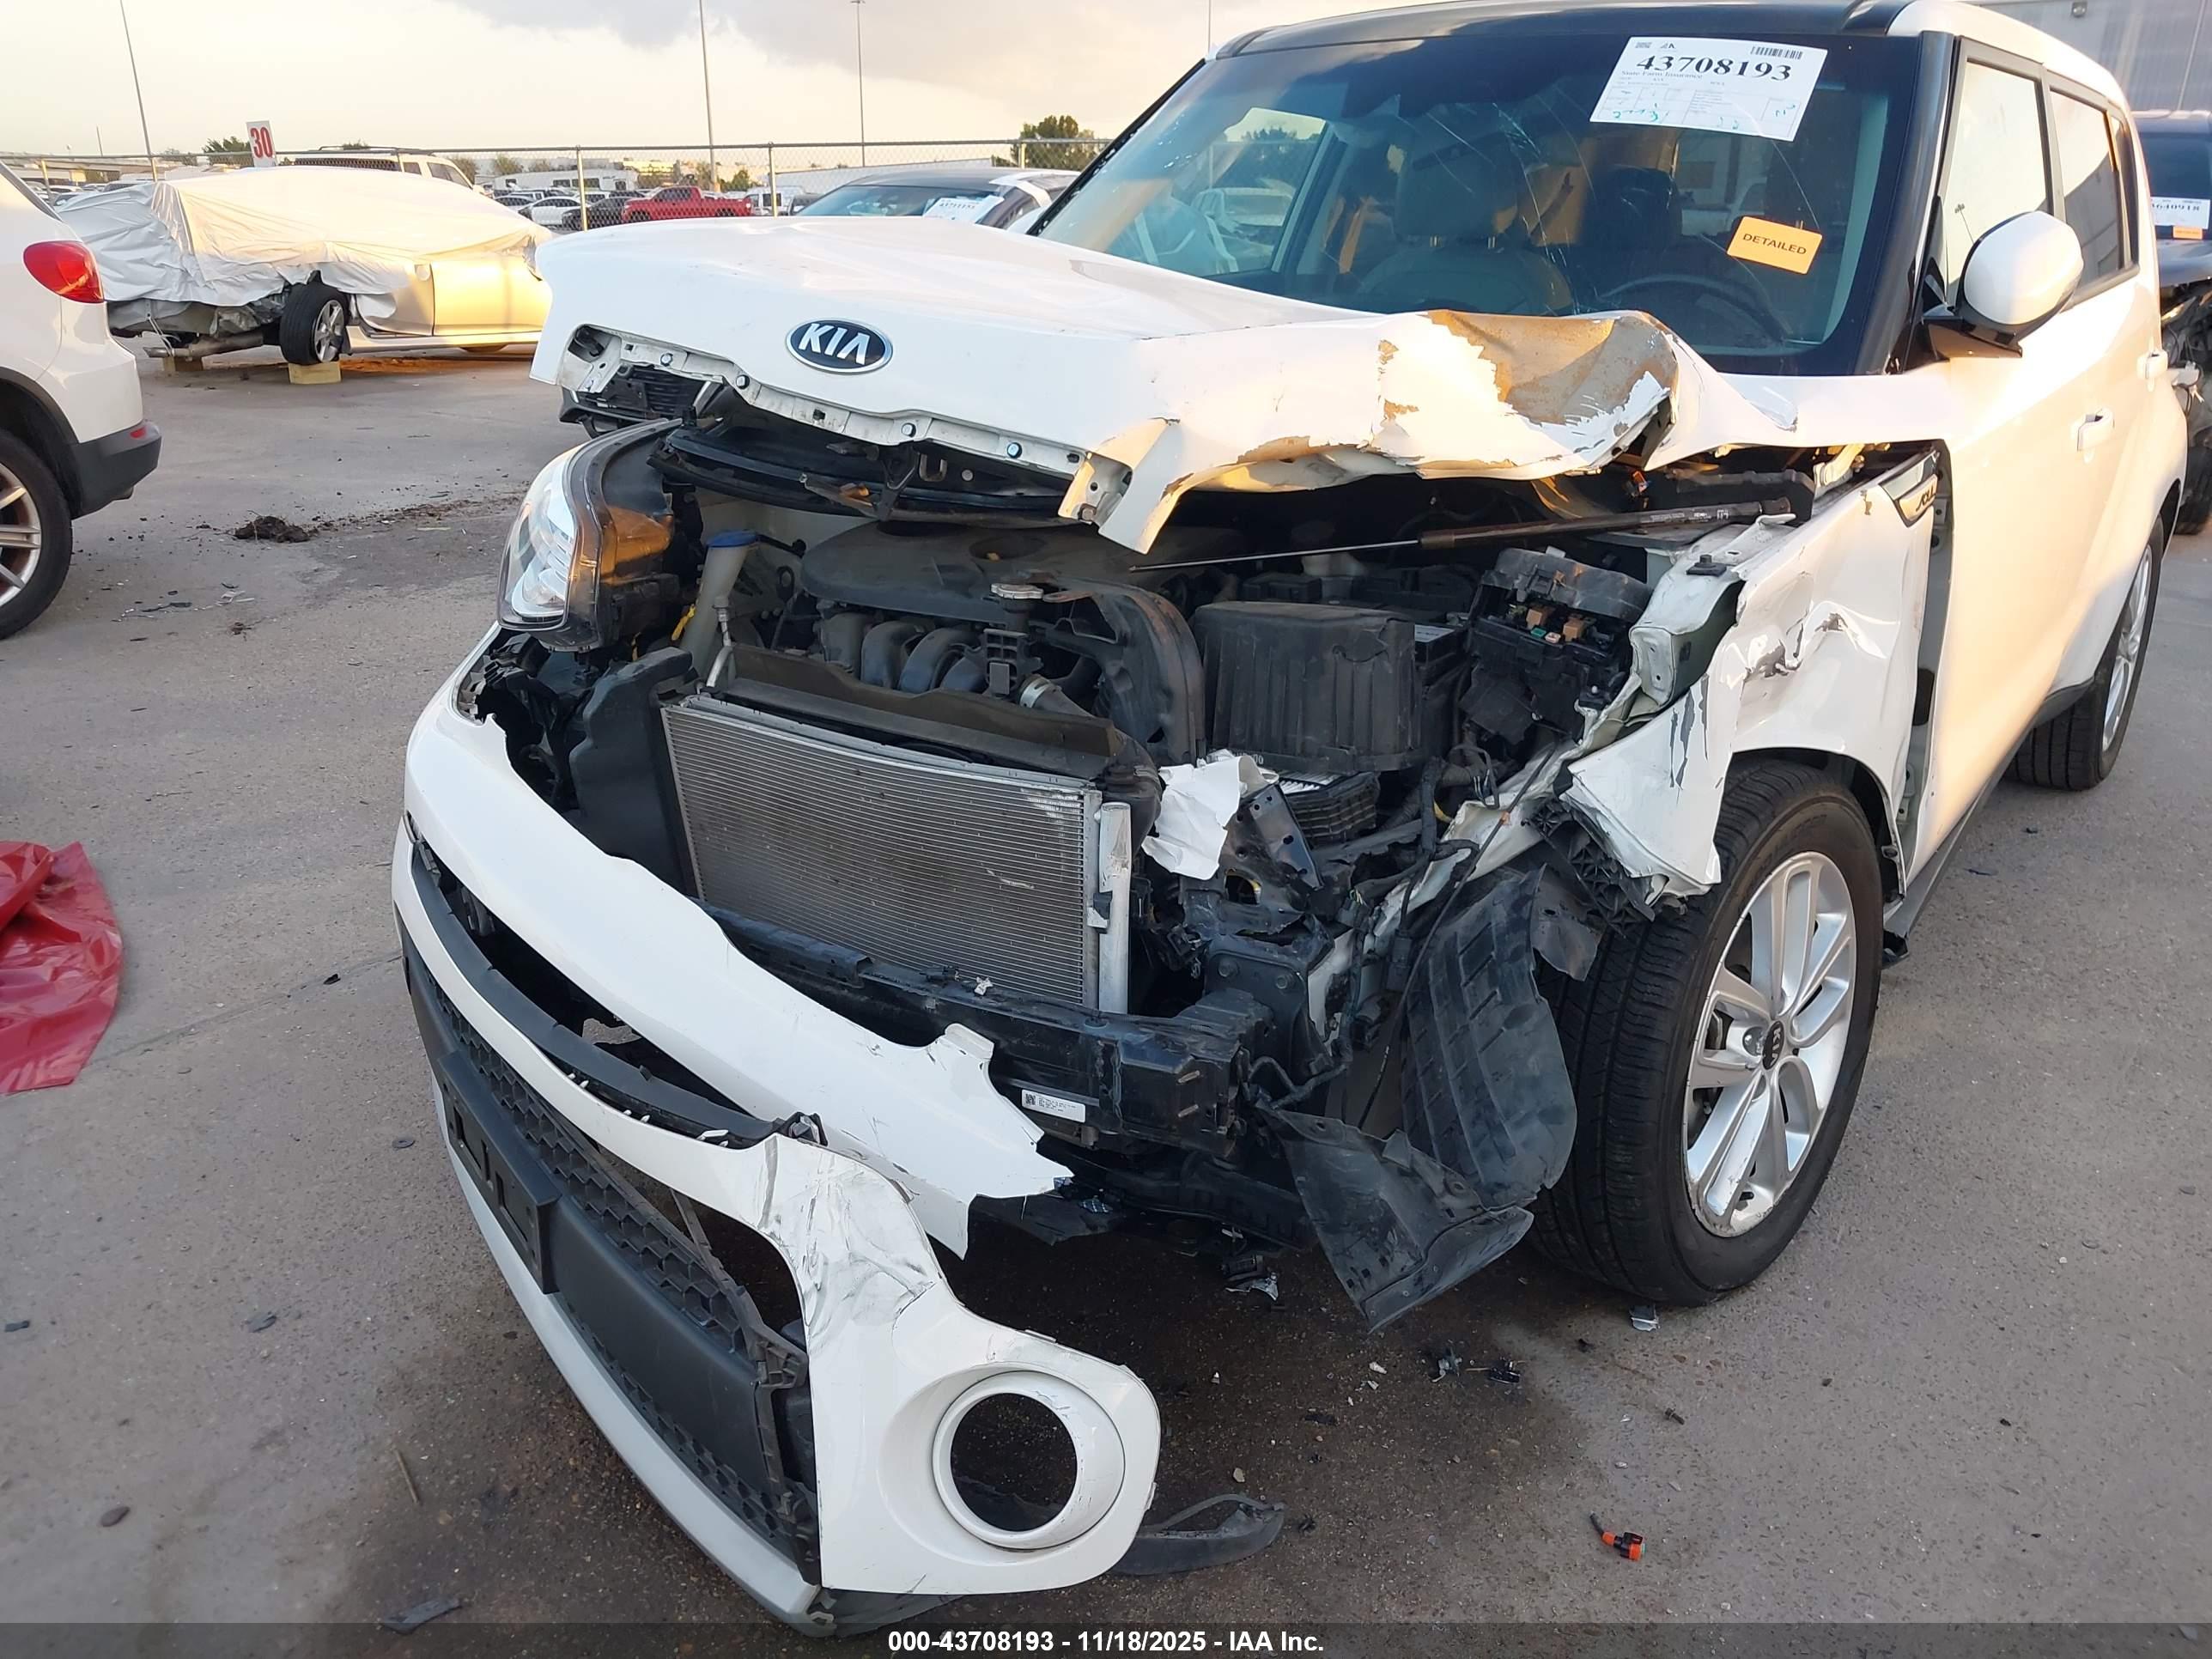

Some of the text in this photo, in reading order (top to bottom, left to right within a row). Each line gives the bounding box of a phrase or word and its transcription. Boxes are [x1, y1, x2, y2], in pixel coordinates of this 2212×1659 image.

[1636, 55, 1791, 81] 43708193
[250, 126, 273, 158] 30
[1742, 233, 1807, 254] DETAILED
[798, 323, 871, 365] KIA
[1771, 1027, 1782, 1066] KIA
